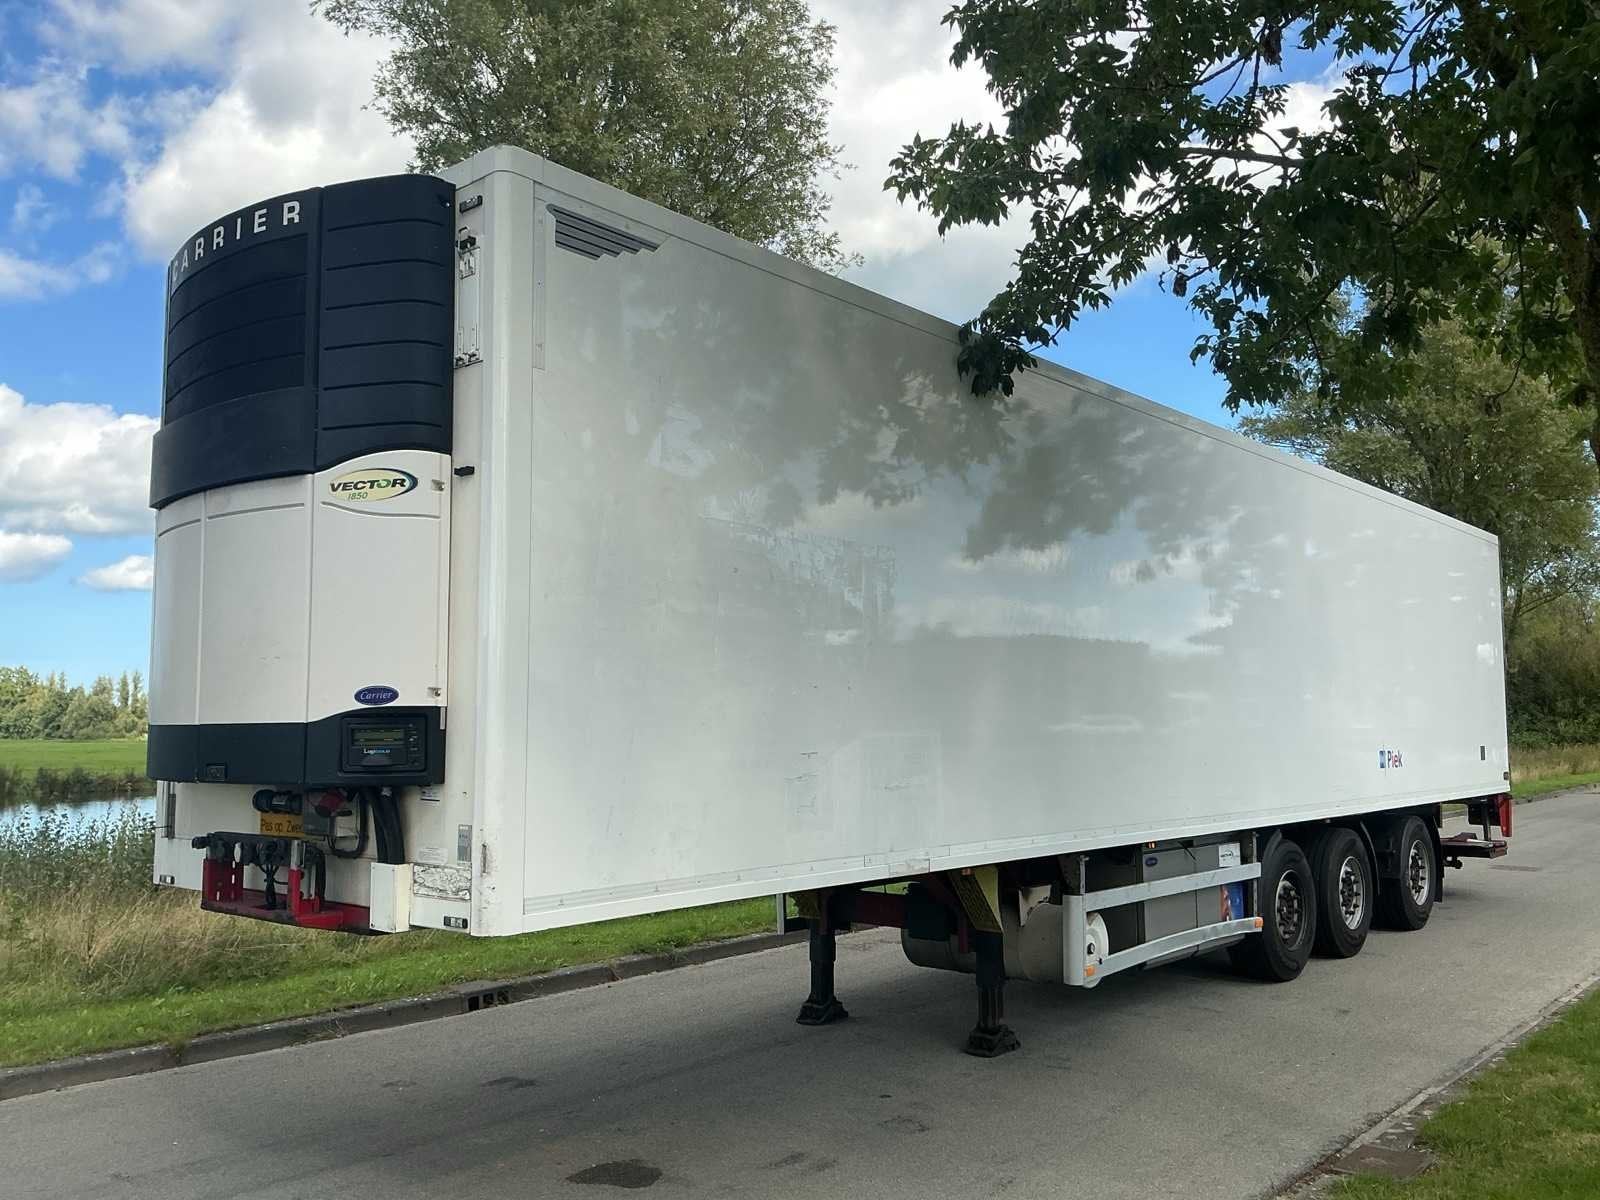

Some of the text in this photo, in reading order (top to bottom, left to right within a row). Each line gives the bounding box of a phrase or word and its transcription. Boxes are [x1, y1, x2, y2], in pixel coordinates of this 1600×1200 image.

[172, 200, 301, 281] CARRIER
[329, 478, 406, 492] VECTOR
[347, 492, 369, 500] 1850
[360, 691, 393, 700] Carrier
[1387, 750, 1403, 768] Piek
